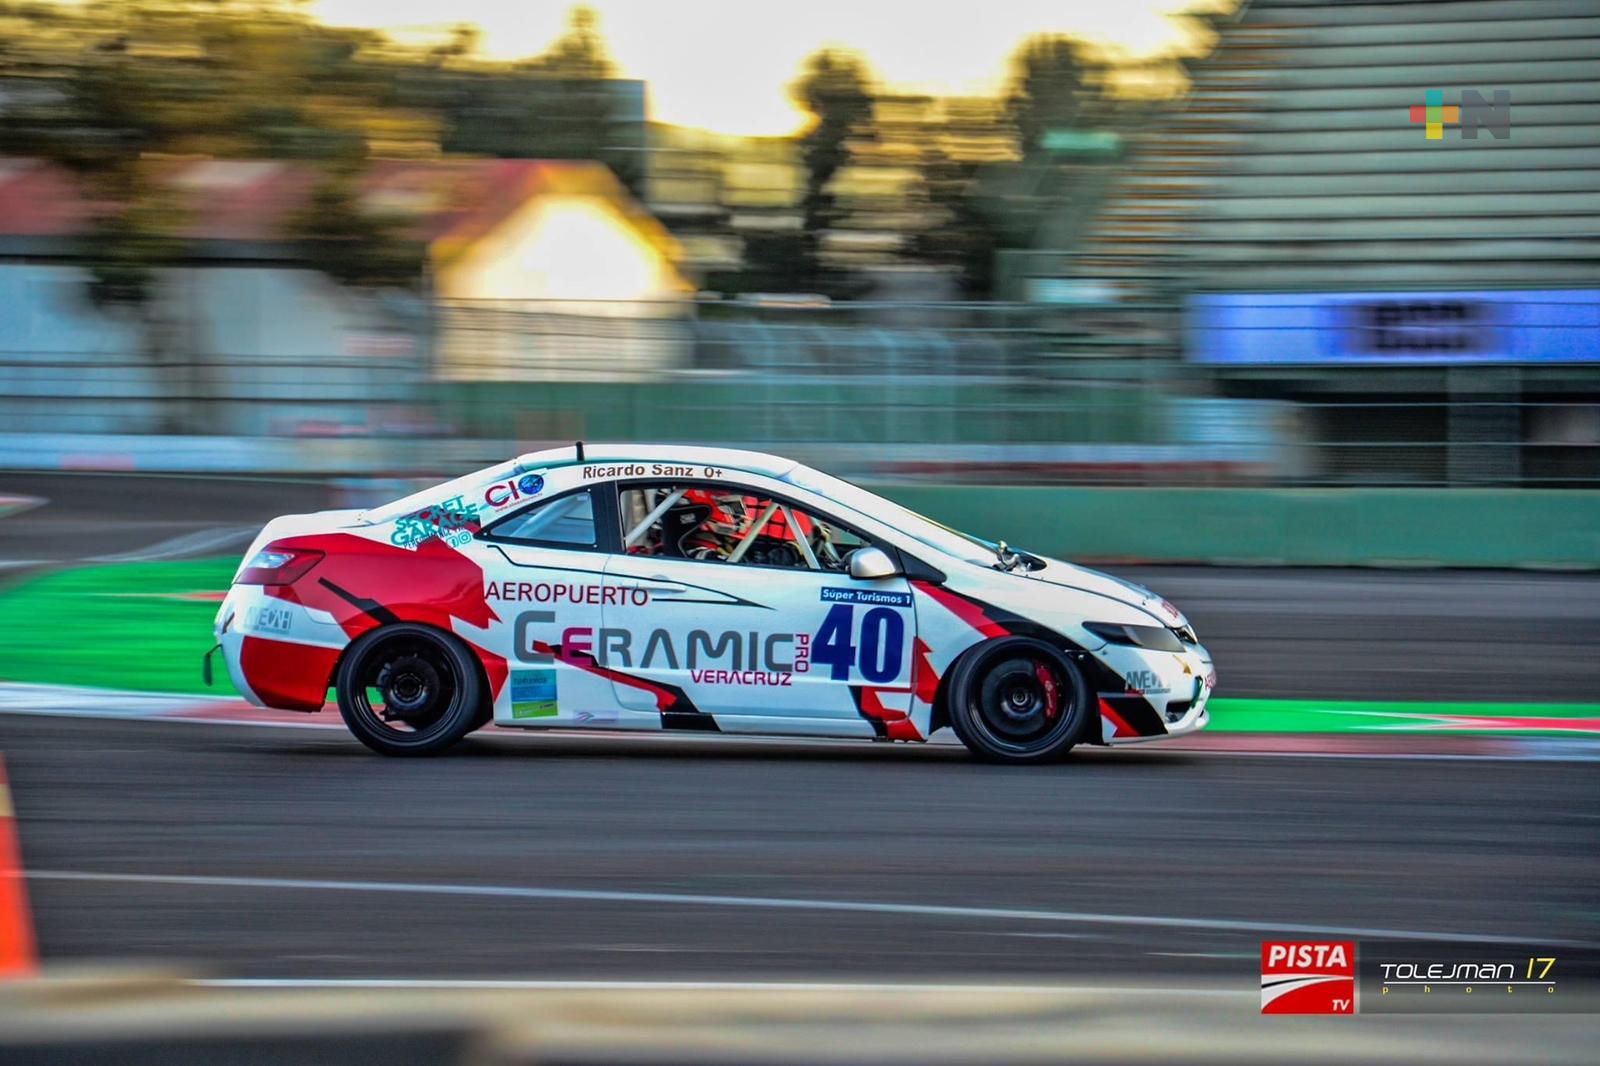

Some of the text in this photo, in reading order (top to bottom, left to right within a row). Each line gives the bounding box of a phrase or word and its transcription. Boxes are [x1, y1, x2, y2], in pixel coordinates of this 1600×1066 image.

[583, 464, 645, 479] Ricardo
[651, 464, 694, 477] Sanz
[391, 503, 478, 545] GARAGE
[395, 495, 464, 530] SECRET
[484, 581, 649, 606] AEROPUERTO
[823, 588, 911, 604] Súper Turismos 1
[513, 610, 795, 672] CERAMIC
[794, 633, 810, 673] PRO
[811, 604, 905, 684] 40
[691, 669, 792, 687] VERACRUZ
